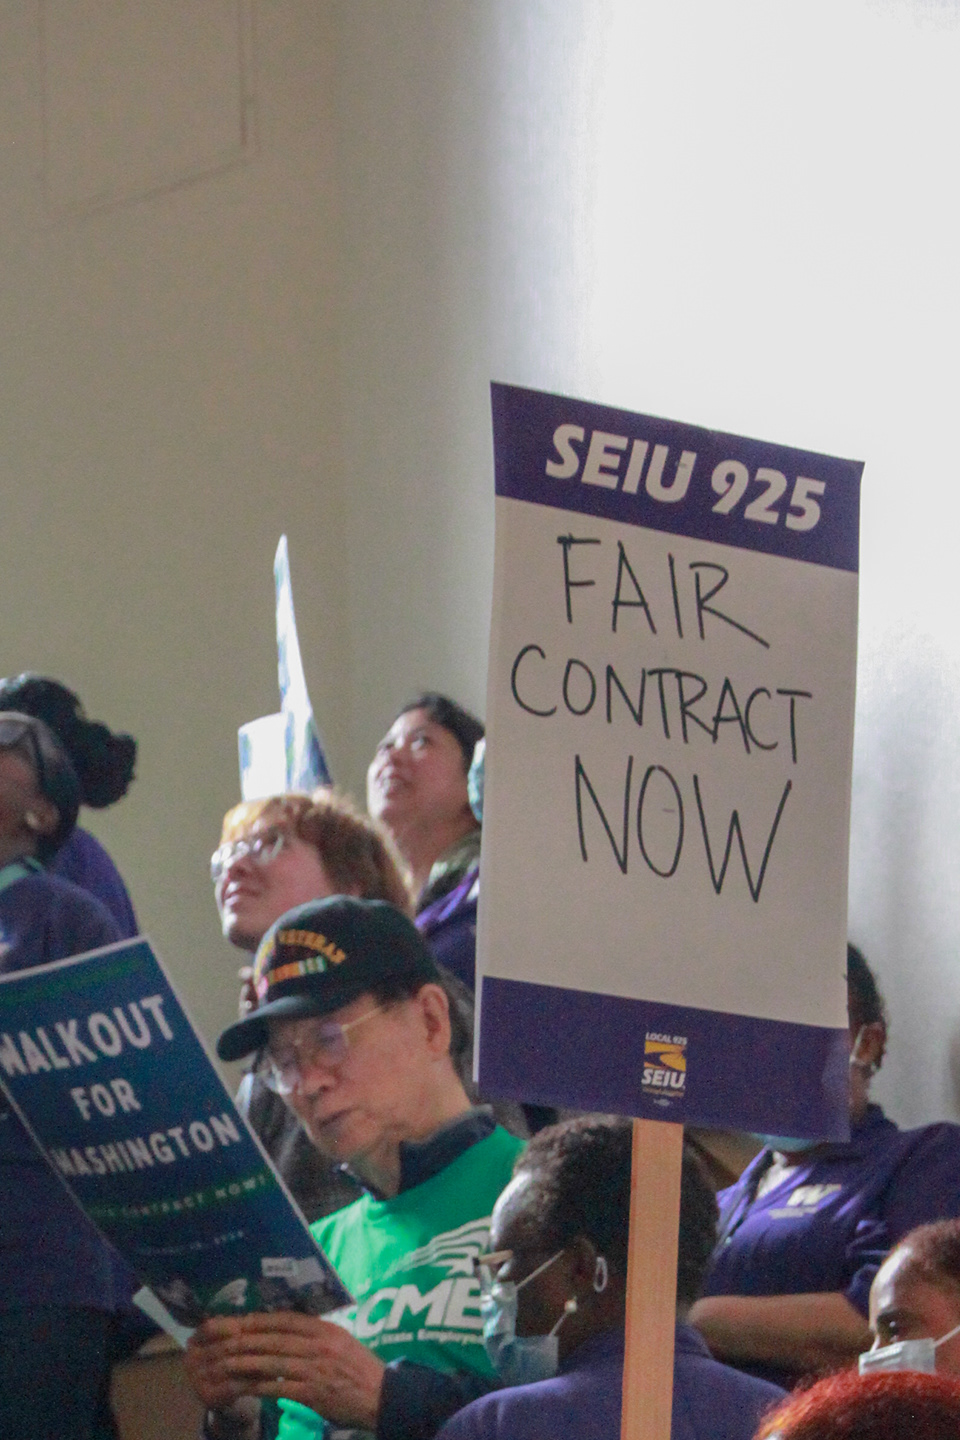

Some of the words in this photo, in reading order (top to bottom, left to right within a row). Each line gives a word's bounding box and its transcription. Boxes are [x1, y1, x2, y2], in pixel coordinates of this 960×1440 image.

[545, 423, 697, 501] SEIU
[709, 459, 826, 533] 925
[556, 533, 771, 649] FAIR
[510, 643, 813, 764] CONTRACT
[574, 753, 793, 903] NOW
[641, 1068, 686, 1089] SEIU
[645, 1032, 672, 1043] LOCAL
[673, 1035, 688, 1046] 925
[70, 1077, 142, 1122] FOR
[49, 1112, 241, 1177] WASHINGTON
